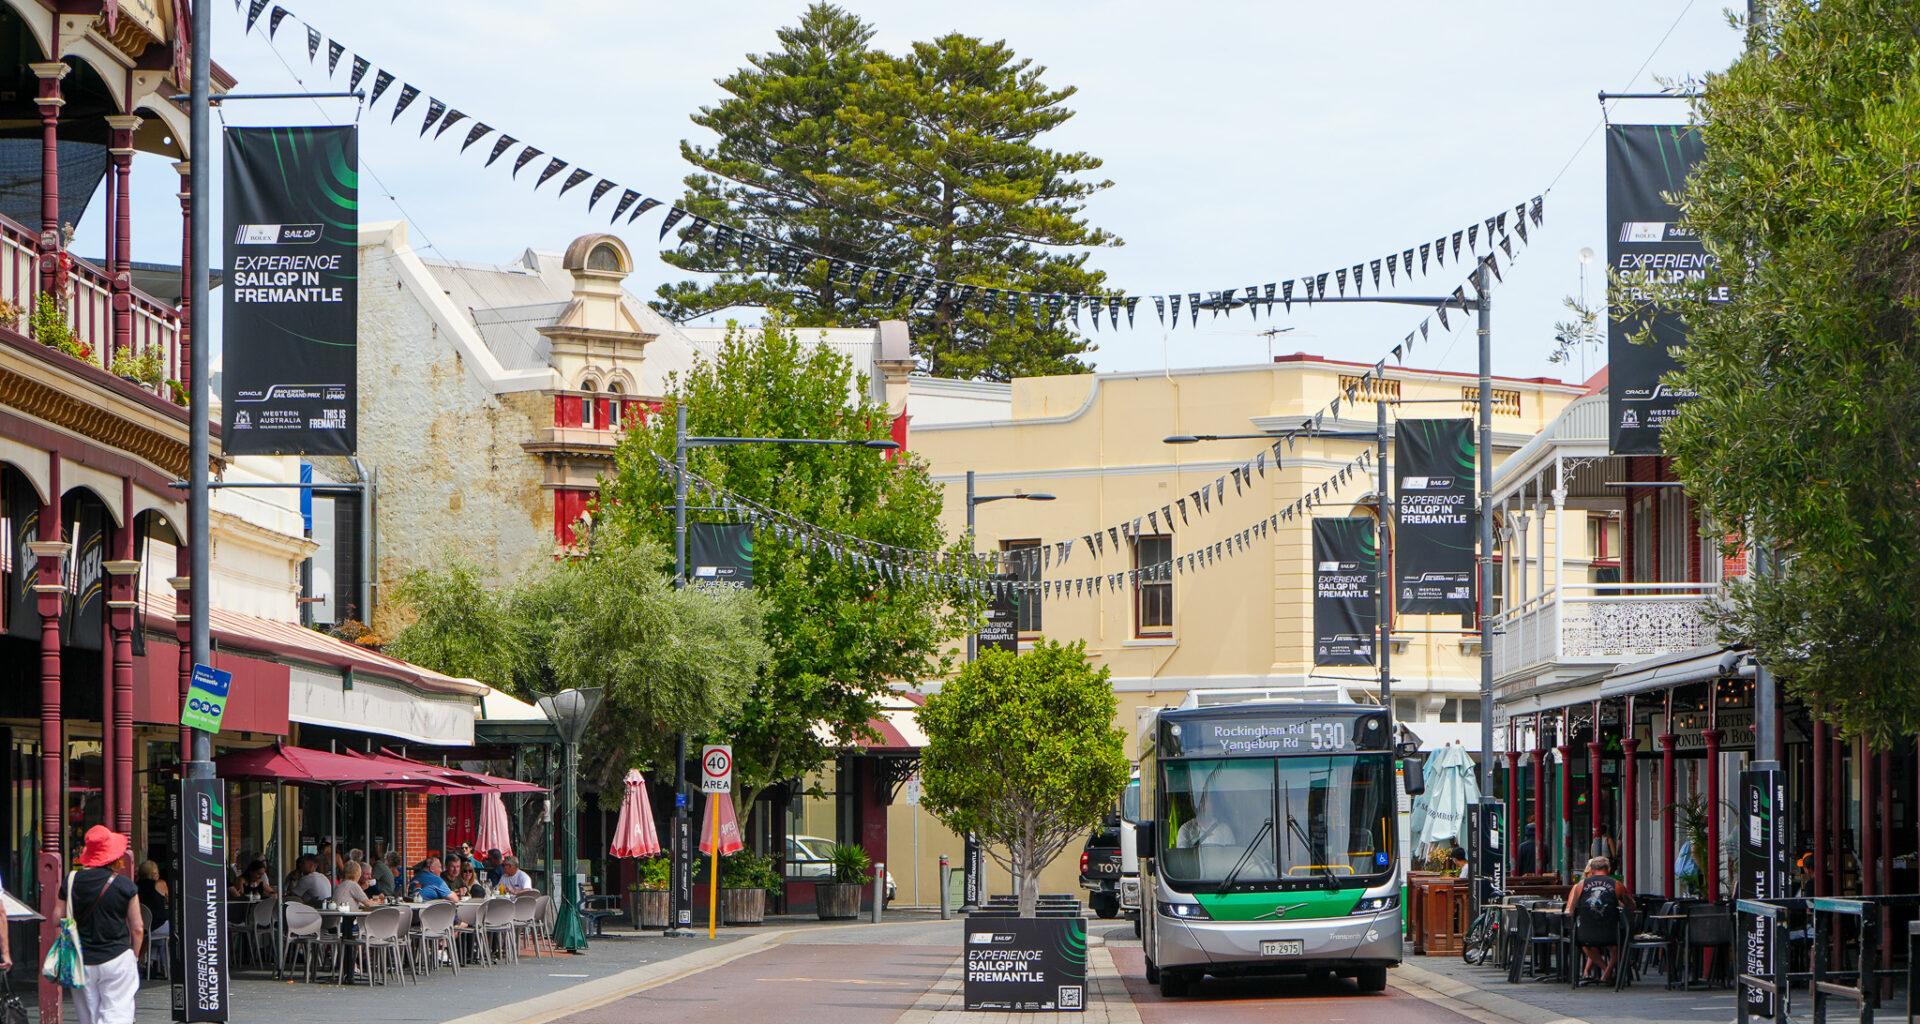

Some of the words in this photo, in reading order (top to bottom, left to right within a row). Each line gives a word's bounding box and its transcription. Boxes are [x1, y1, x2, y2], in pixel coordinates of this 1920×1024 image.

[234, 255, 342, 270] EXPERIENCE
[234, 271, 299, 286] SAILGP
[302, 272, 320, 286] IN
[234, 288, 343, 303] FREMANTLE
[323, 409, 338, 419] THIS
[338, 409, 347, 419] IS
[309, 418, 347, 429] FREMANTLE
[1401, 495, 1466, 504] EXPERIENCE
[1401, 504, 1440, 514] SAILGP
[1441, 505, 1453, 514] IN
[1401, 514, 1467, 524] FREMANTLE
[1318, 575, 1368, 583] EXPERIENCE
[1318, 590, 1369, 598] FREMANTLE
[195, 675, 218, 686] Fremantle
[1685, 713, 1752, 730] ELIZBETH'S
[1214, 725, 1286, 738] Rockingham
[1288, 724, 1304, 735] Rd
[1310, 722, 1345, 750] 530
[1220, 738, 1279, 752] Yangebup
[1283, 737, 1299, 748] Rd
[707, 757, 726, 770] 40
[703, 780, 730, 790] AREA
[1098, 863, 1122, 873] TOY
[1755, 871, 1765, 944] FRENTLE
[206, 878, 218, 952] FREMANTLE
[1265, 945, 1276, 954] TP
[1278, 944, 1299, 954] 2975
[1756, 946, 1764, 958] IN
[207, 953, 218, 966] IN
[968, 950, 1043, 961] EXPERIENCE
[968, 961, 1013, 971] SAILGP
[1015, 961, 1028, 971] IN
[1747, 931, 1757, 1003] EXRIENCE
[197, 938, 208, 1011] EXPERIENCE
[968, 972, 1044, 982] FREMANTLE
[1756, 961, 1764, 1003] SAGP
[208, 967, 219, 1011] SAILGP
